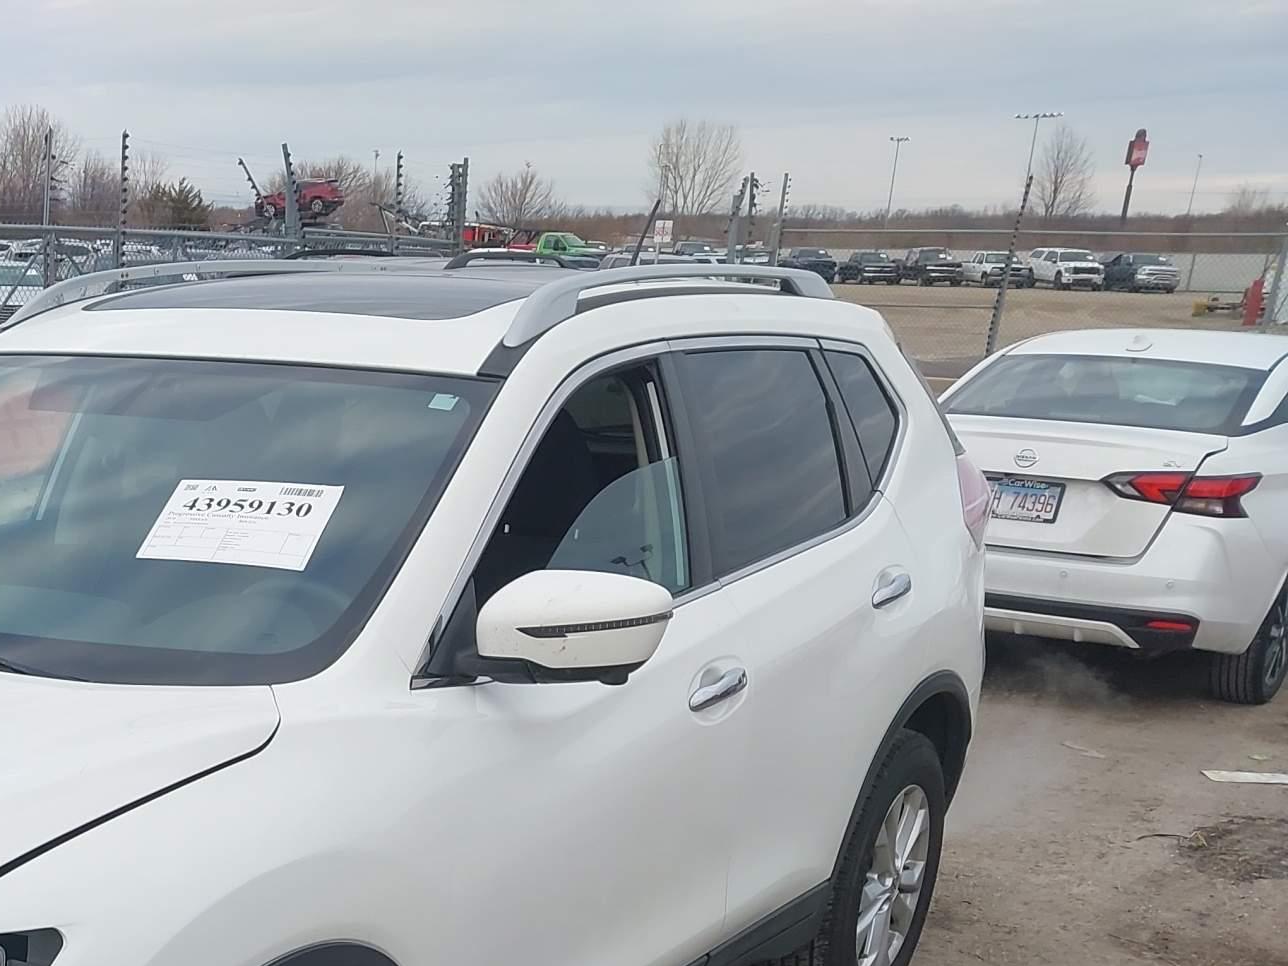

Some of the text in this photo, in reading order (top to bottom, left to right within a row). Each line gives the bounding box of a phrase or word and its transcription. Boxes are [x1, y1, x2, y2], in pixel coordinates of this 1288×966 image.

[1008, 478, 1047, 489] CarWise
[183, 496, 313, 518] 43959130
[1010, 491, 1056, 514] 74396
